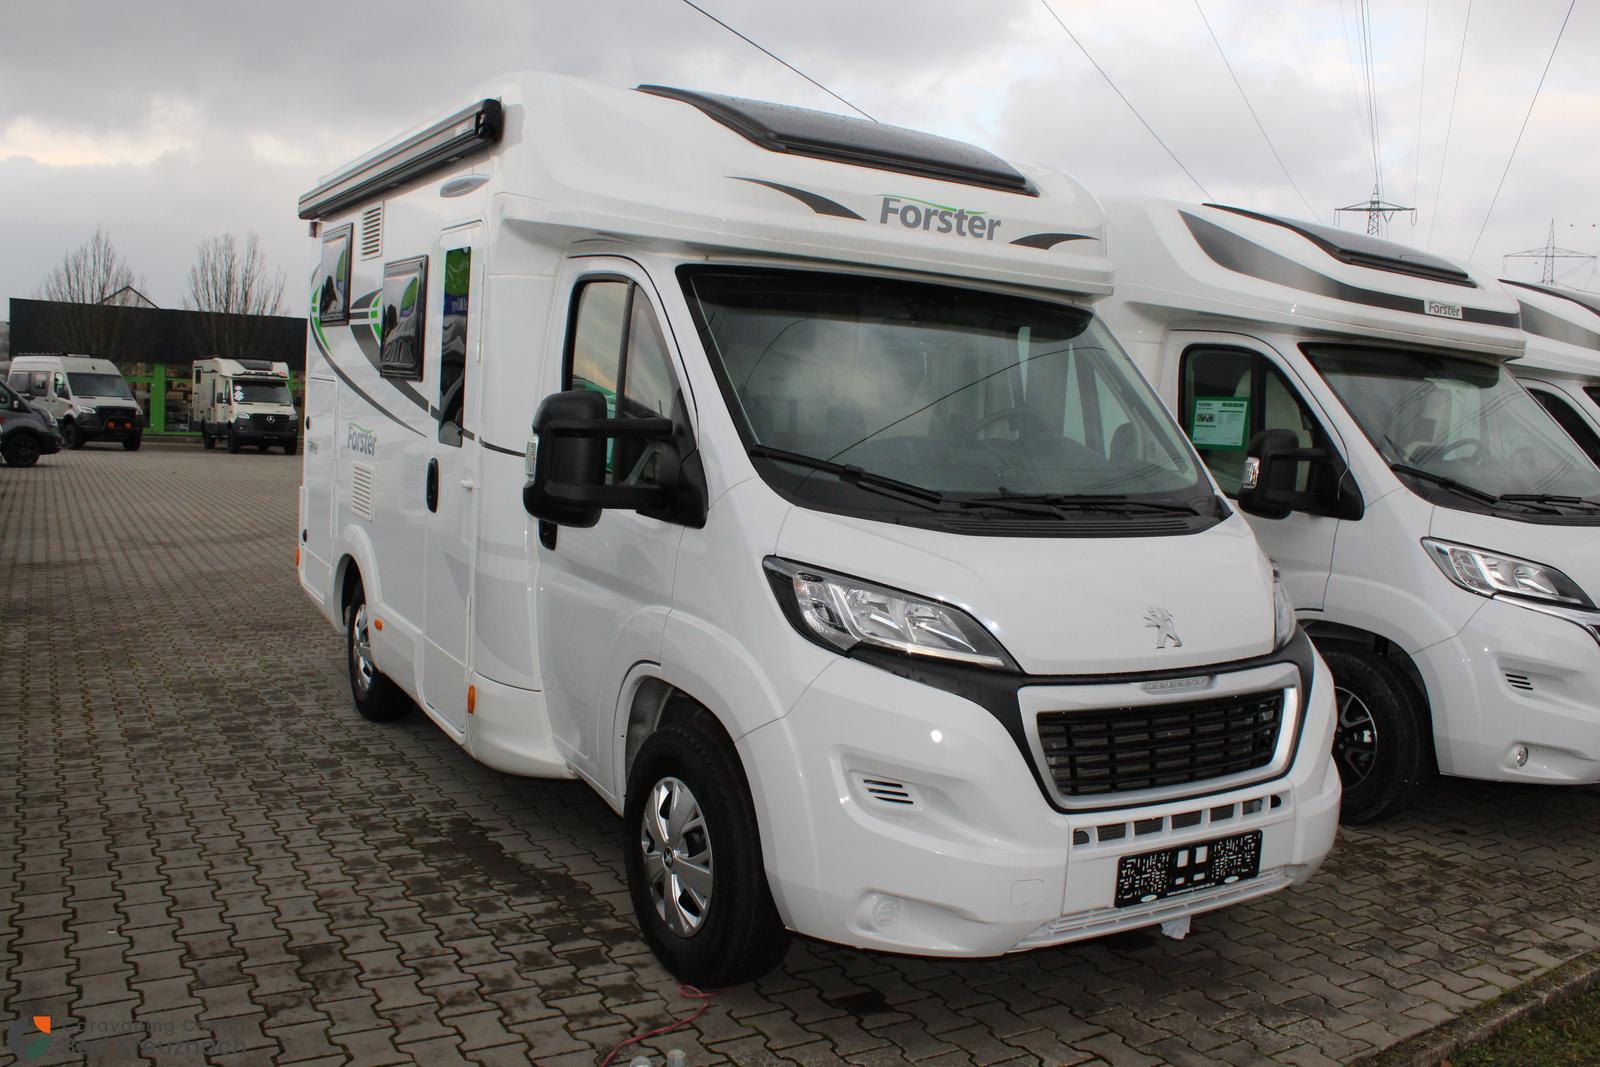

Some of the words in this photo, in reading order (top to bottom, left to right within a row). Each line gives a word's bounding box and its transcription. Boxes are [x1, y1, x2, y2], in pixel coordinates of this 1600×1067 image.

[880, 196, 1002, 241] Forster
[1429, 301, 1460, 316] Forster
[347, 425, 377, 456] Forster
